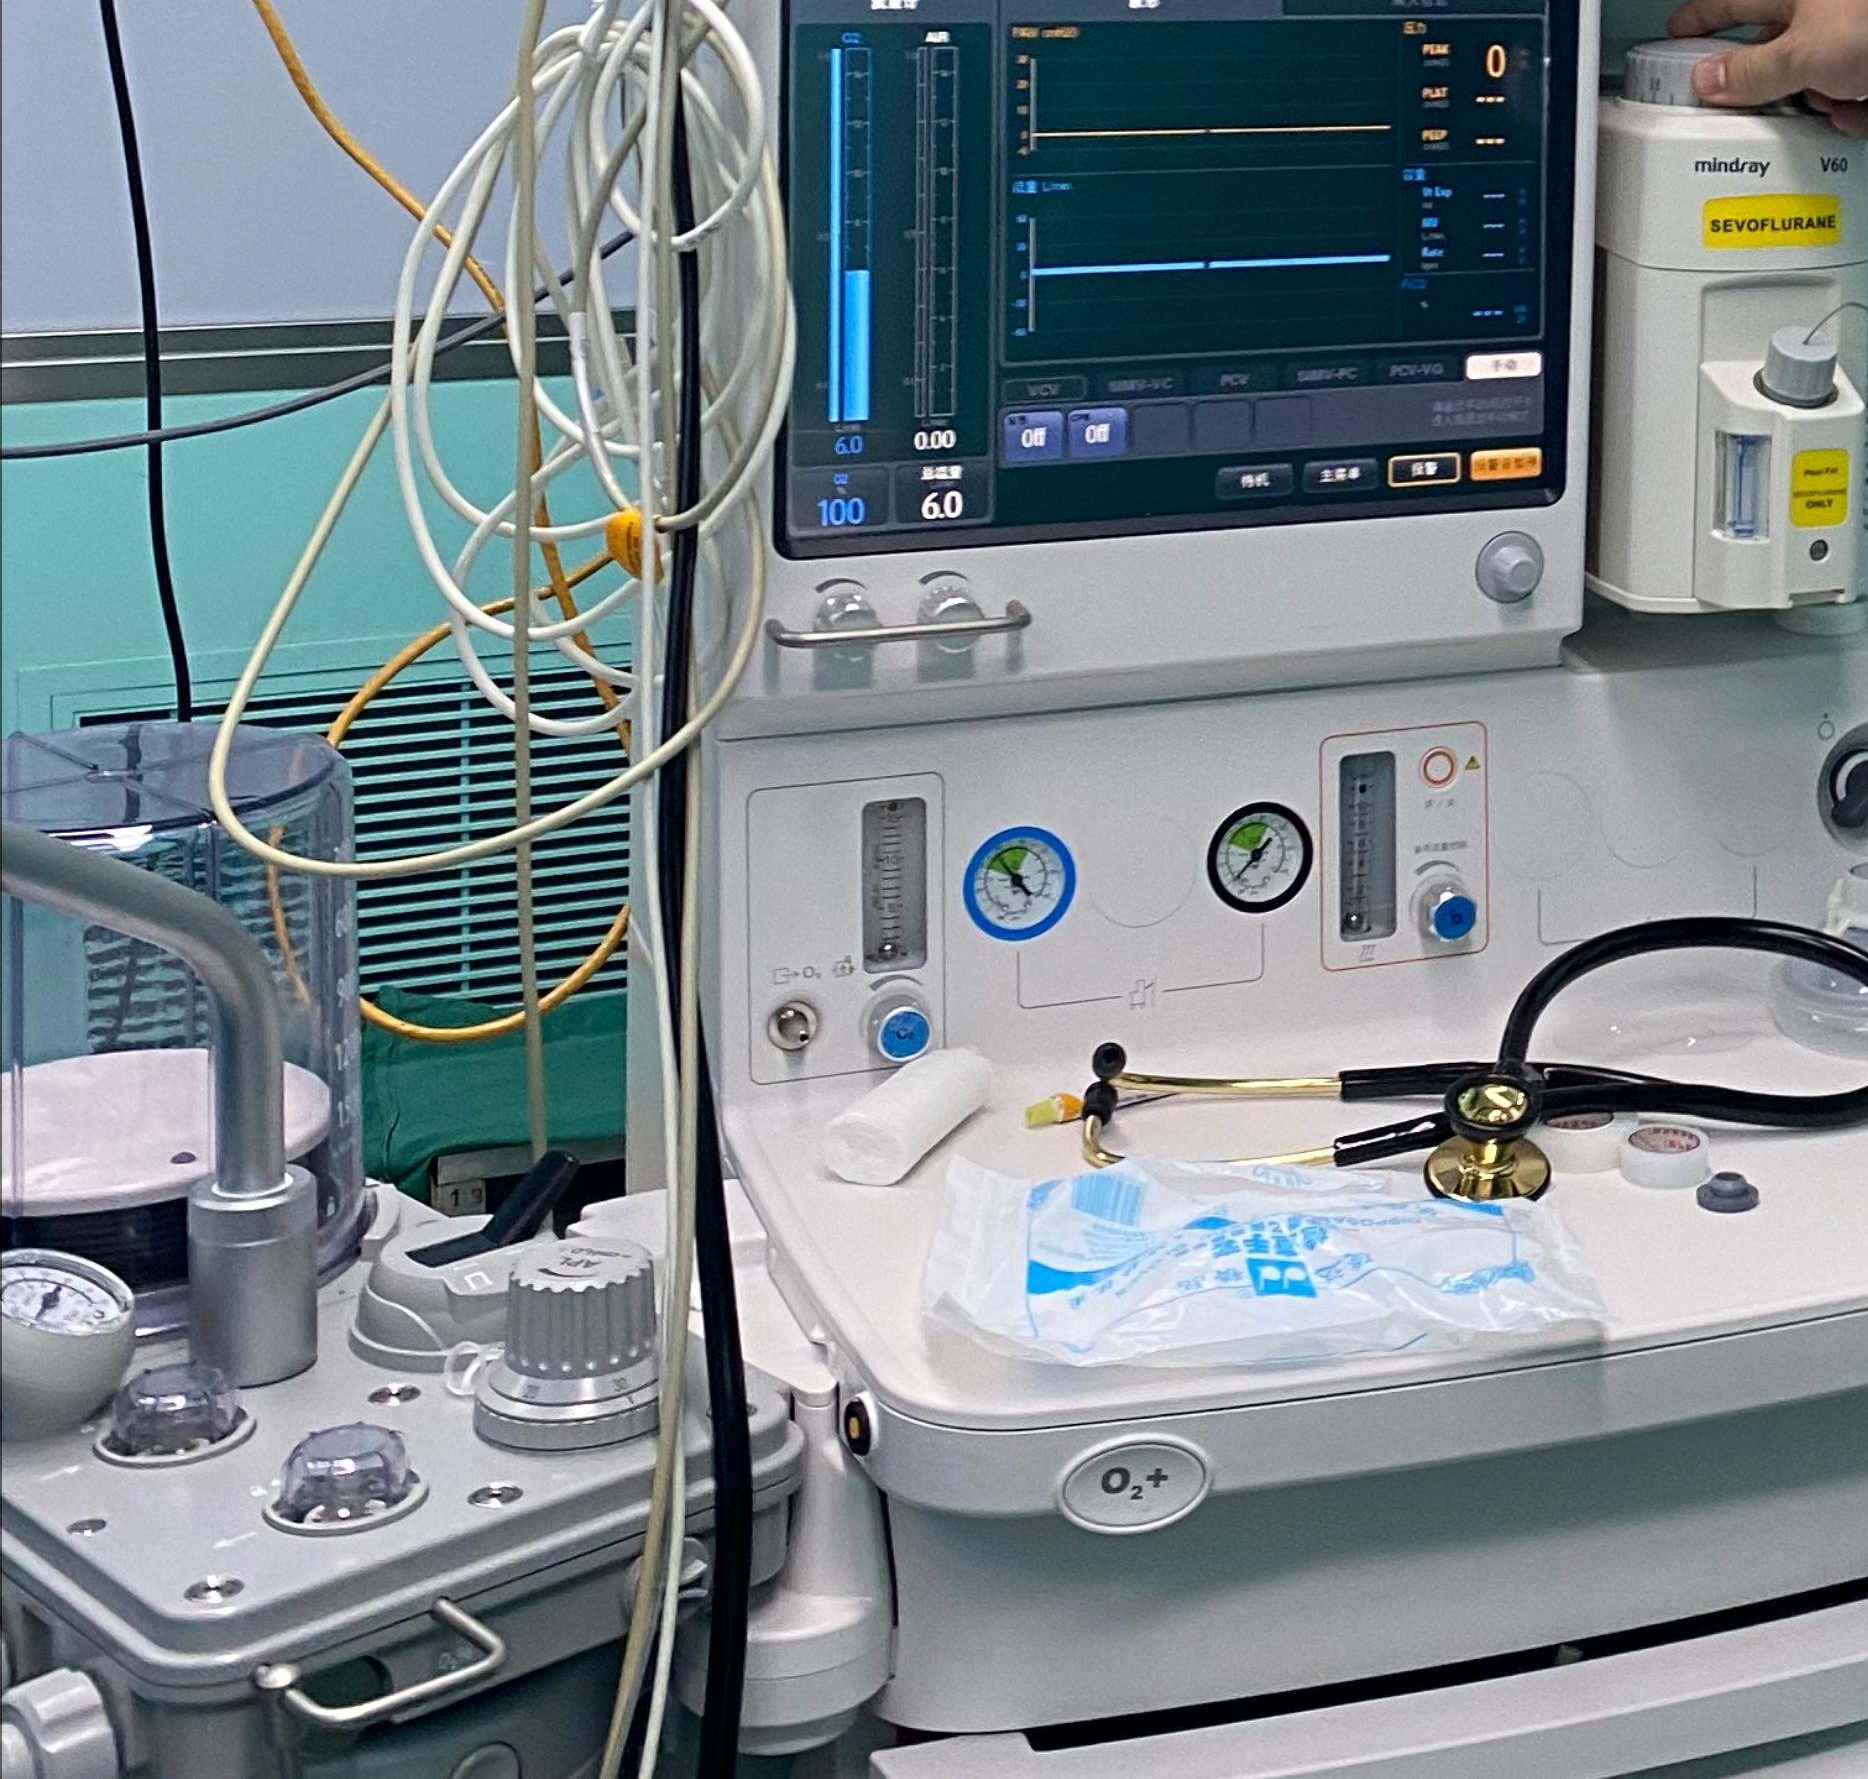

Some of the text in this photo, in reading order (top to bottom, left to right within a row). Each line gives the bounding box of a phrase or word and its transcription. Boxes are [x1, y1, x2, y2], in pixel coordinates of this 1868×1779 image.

[1486, 44, 1507, 79] 0
[1695, 156, 1848, 178] mindray V60
[1710, 215, 1836, 233] SEVOFLURANE
[914, 429, 957, 450] 0.00
[1021, 426, 1047, 448] Off
[1085, 423, 1111, 444] Off
[835, 435, 863, 455] 6.0
[817, 497, 865, 526] 100
[921, 490, 963, 519] 6.0
